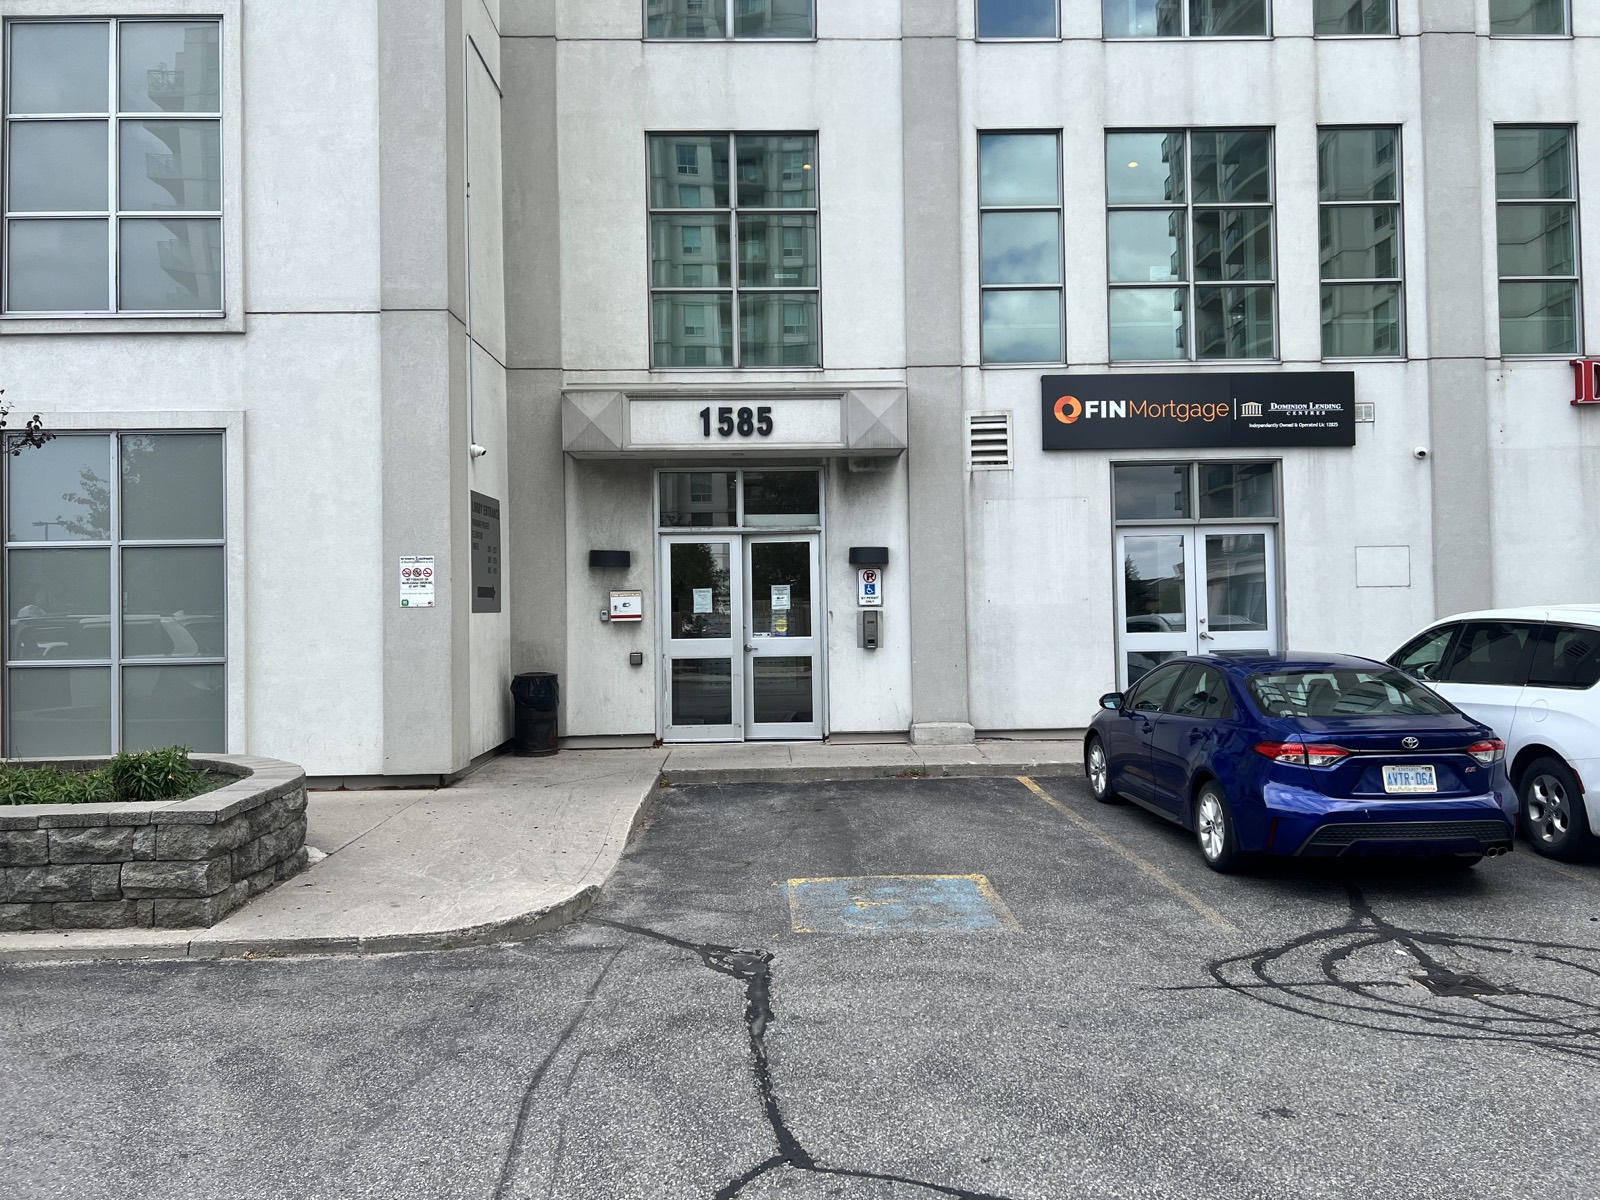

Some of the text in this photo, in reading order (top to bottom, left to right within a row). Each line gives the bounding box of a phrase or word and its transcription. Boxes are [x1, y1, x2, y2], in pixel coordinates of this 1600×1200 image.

[1270, 402, 1342, 410] DOMINION LENDING
[700, 406, 773, 437] 1585
[483, 504, 500, 520] ENTRANCE
